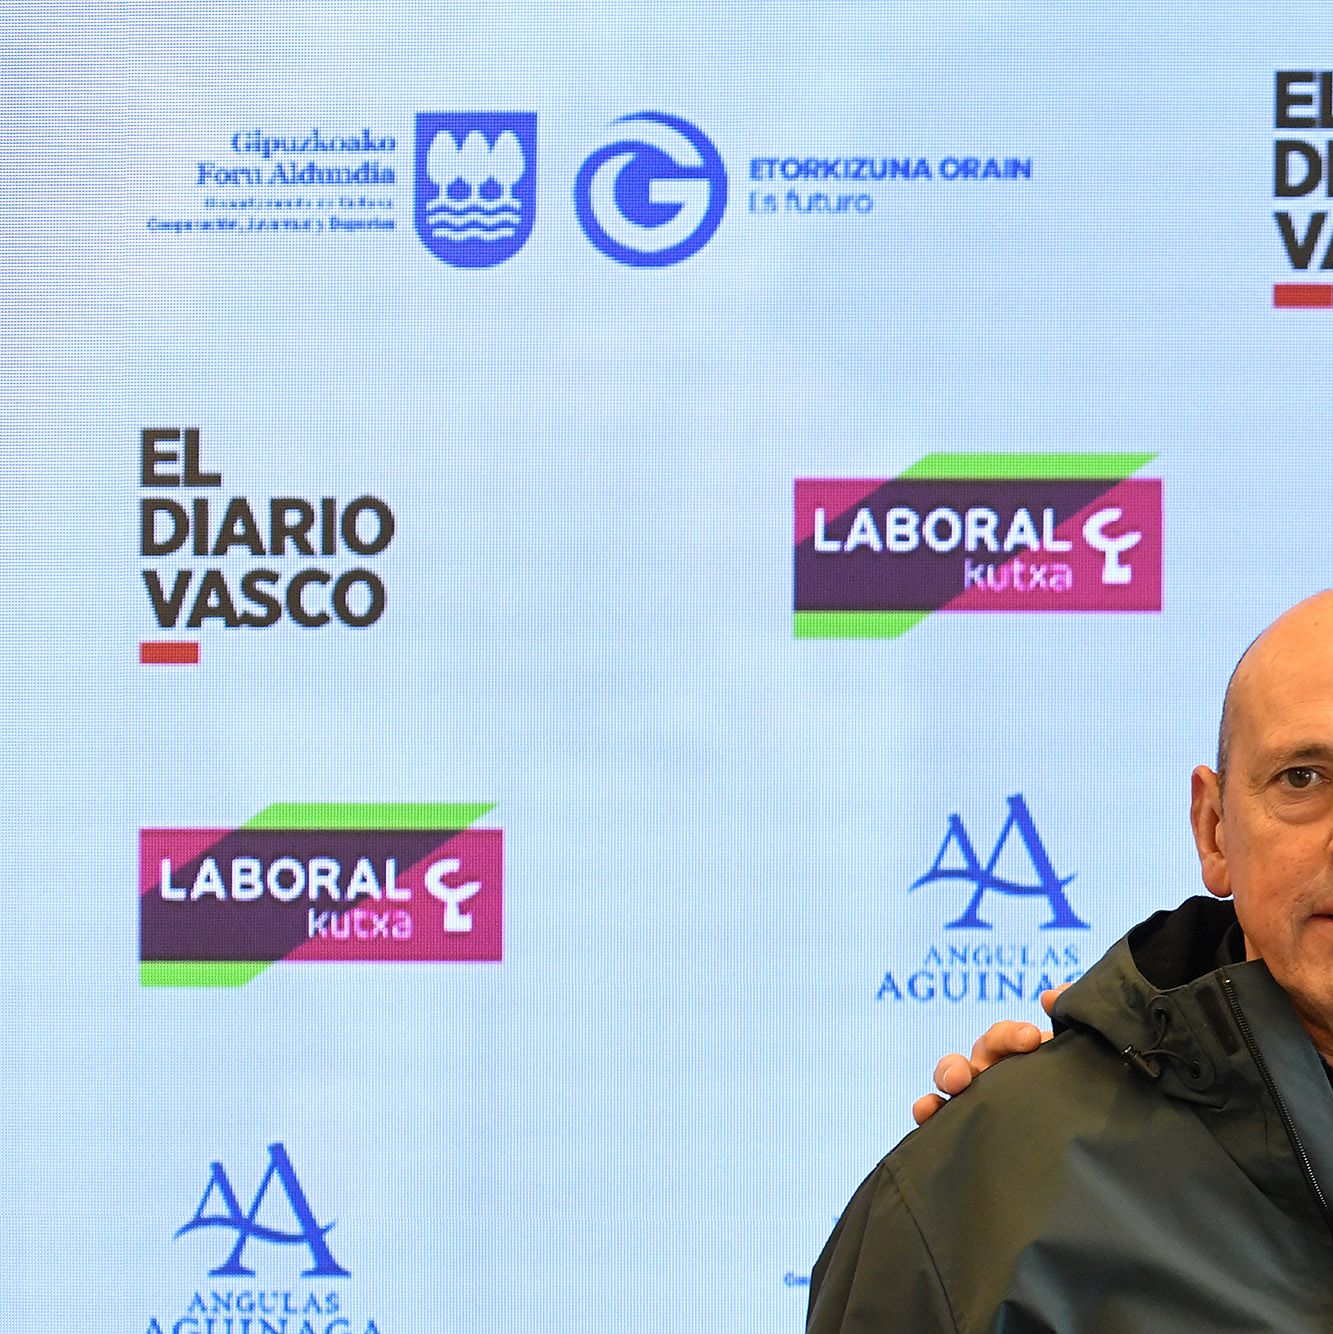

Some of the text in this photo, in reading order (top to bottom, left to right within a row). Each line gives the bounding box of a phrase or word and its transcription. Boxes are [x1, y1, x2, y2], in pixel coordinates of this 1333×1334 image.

[197, 161, 395, 186] Foru Aldundia
[750, 157, 1032, 181] ETORKIZUNA ORAIN
[785, 189, 874, 213] futuro
[140, 428, 222, 488] EL
[139, 495, 395, 557] DIARIO
[815, 508, 1072, 551] LABORAL
[965, 560, 1072, 588] kutxa
[141, 568, 386, 629] VASCO
[161, 858, 411, 901] LABORAL
[308, 909, 411, 938] kutxa
[924, 946, 1079, 966] ANGULAS
[876, 971, 1082, 1003] AGUINA
[188, 1291, 339, 1315] ANGULAS
